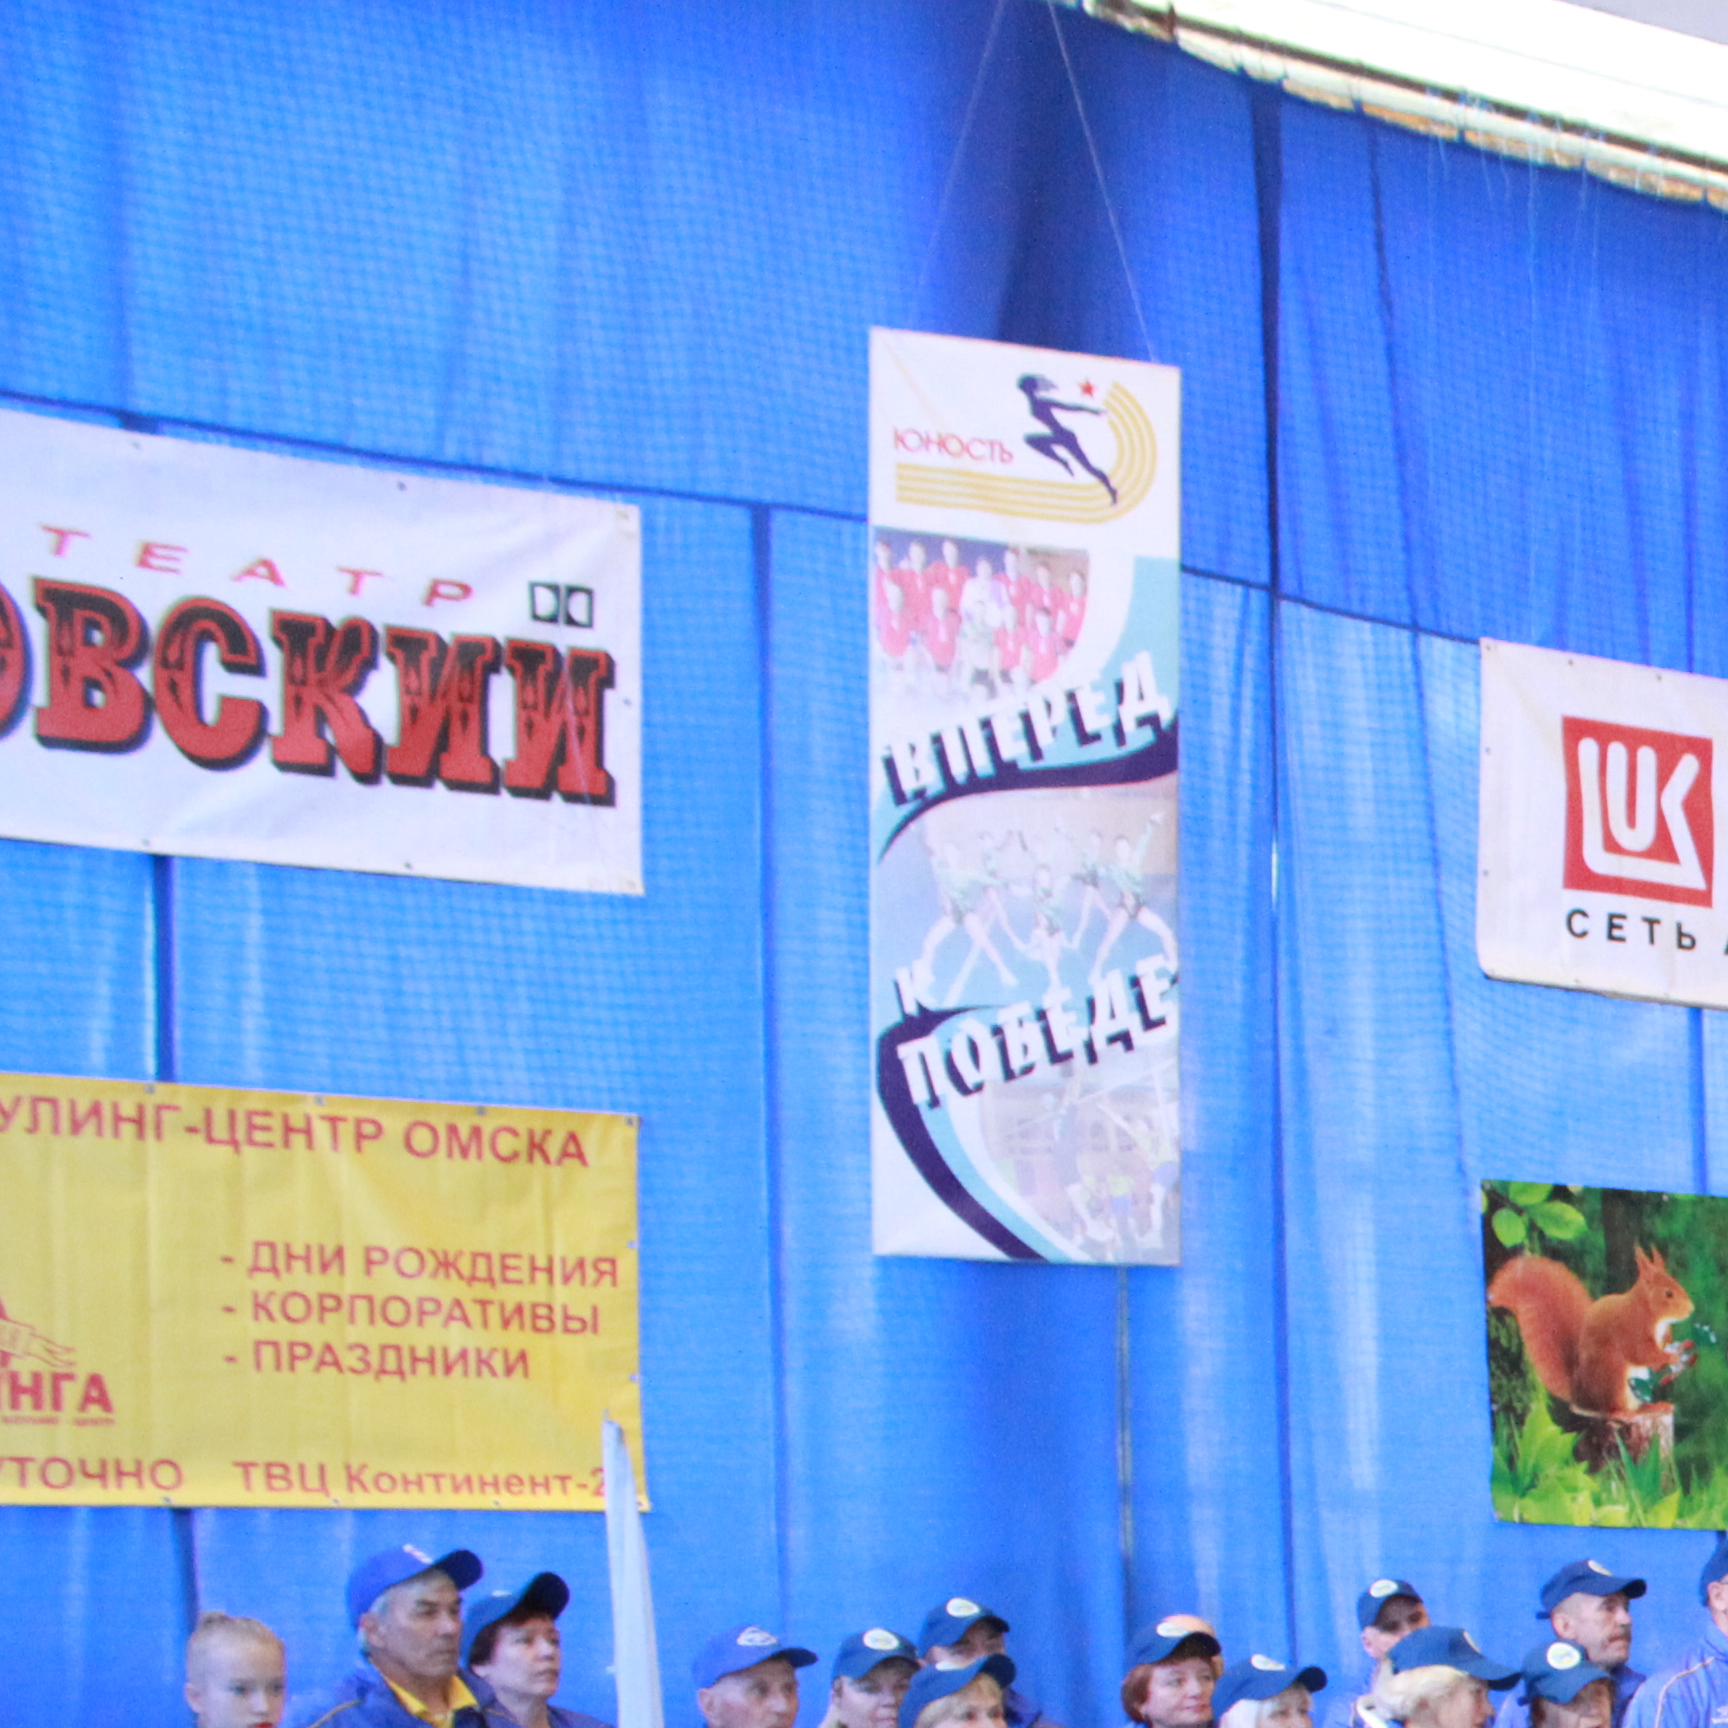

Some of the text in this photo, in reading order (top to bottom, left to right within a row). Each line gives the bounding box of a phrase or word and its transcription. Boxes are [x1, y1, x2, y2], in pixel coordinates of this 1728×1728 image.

[893, 427, 1014, 464] ЮНОСТЬ
[40, 524, 474, 606] ТЕАТР
[884, 650, 1174, 800] ВПЕРЕД
[1566, 909, 1697, 951] СЕТЬ
[897, 954, 1176, 1108] ПОБЕДЕ
[403, 1120, 590, 1168] ОМСКА
[248, 1240, 619, 1289] ДНИ РОЖДЕНИЯ
[250, 1291, 600, 1336] КОРПОРАТИВЫ
[253, 1339, 531, 1383] ПРАЗДНИКИ
[0, 1456, 184, 1493] ТОЧНО
[233, 1461, 333, 1499] ТВЦ
